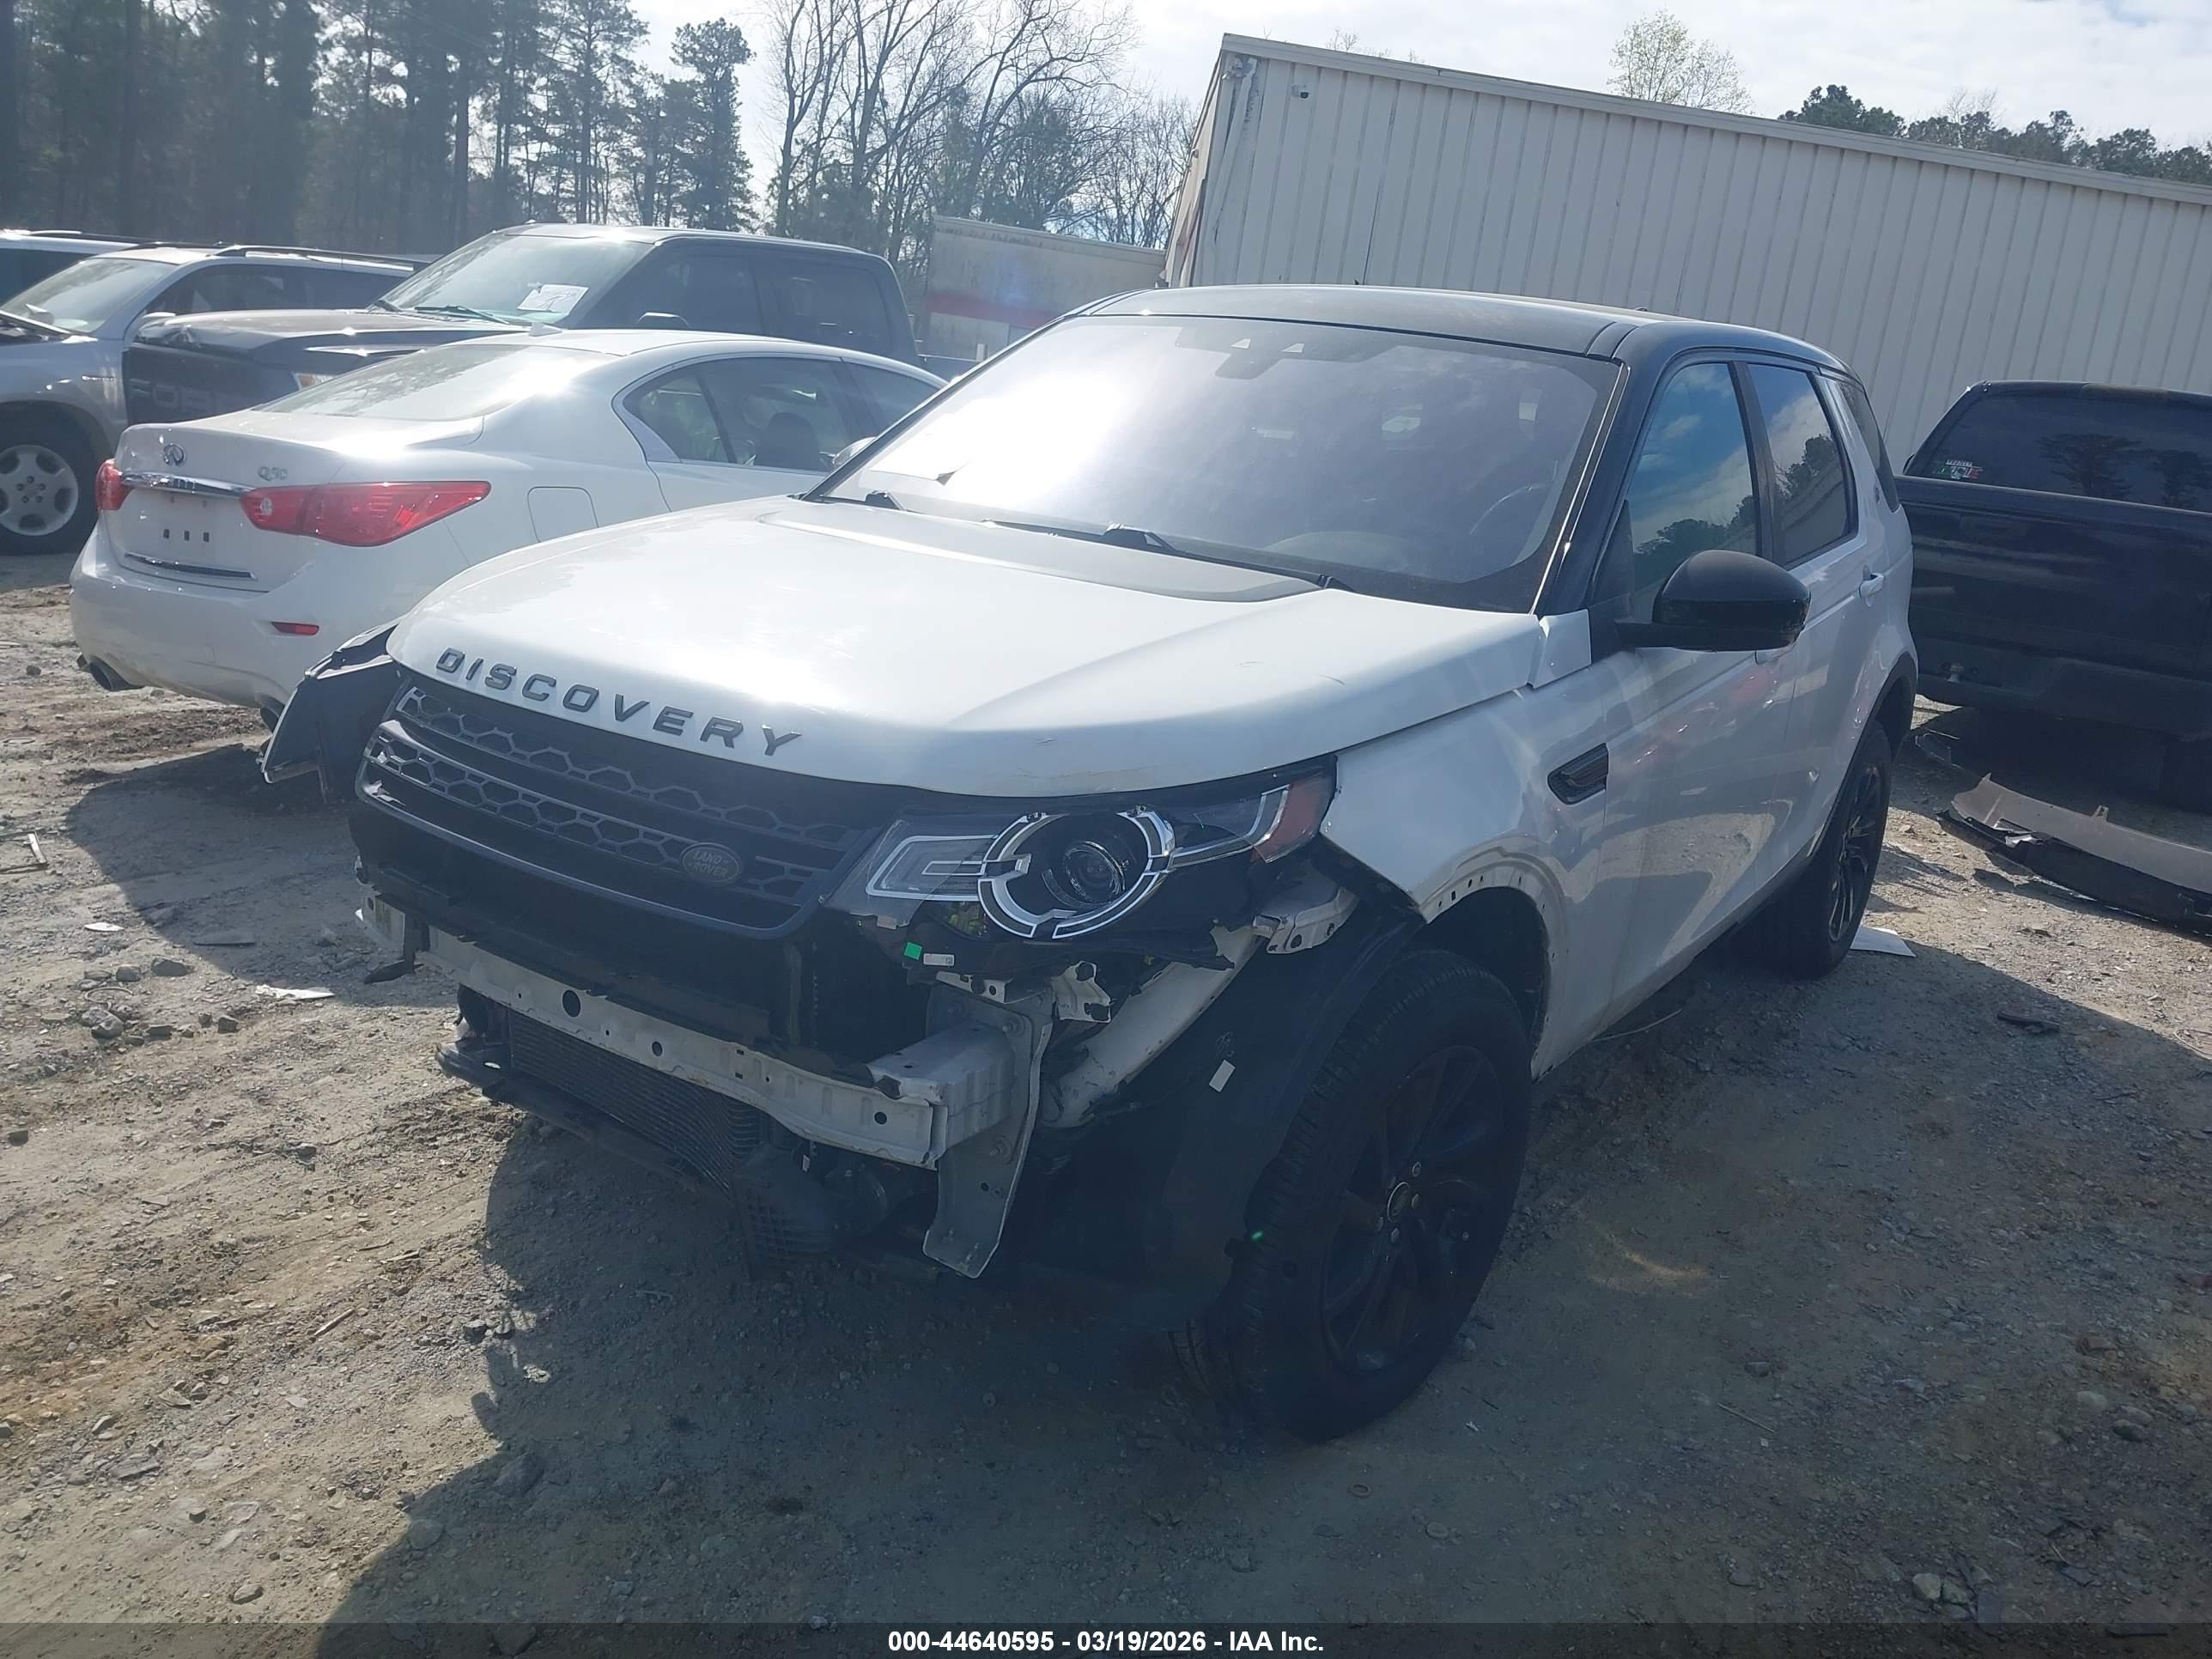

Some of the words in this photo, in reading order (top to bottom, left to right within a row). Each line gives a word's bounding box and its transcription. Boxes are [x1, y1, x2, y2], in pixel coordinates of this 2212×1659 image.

[257, 466, 289, 481] Q50
[435, 647, 802, 756] DISCOVERY
[693, 850, 723, 865] LAND
